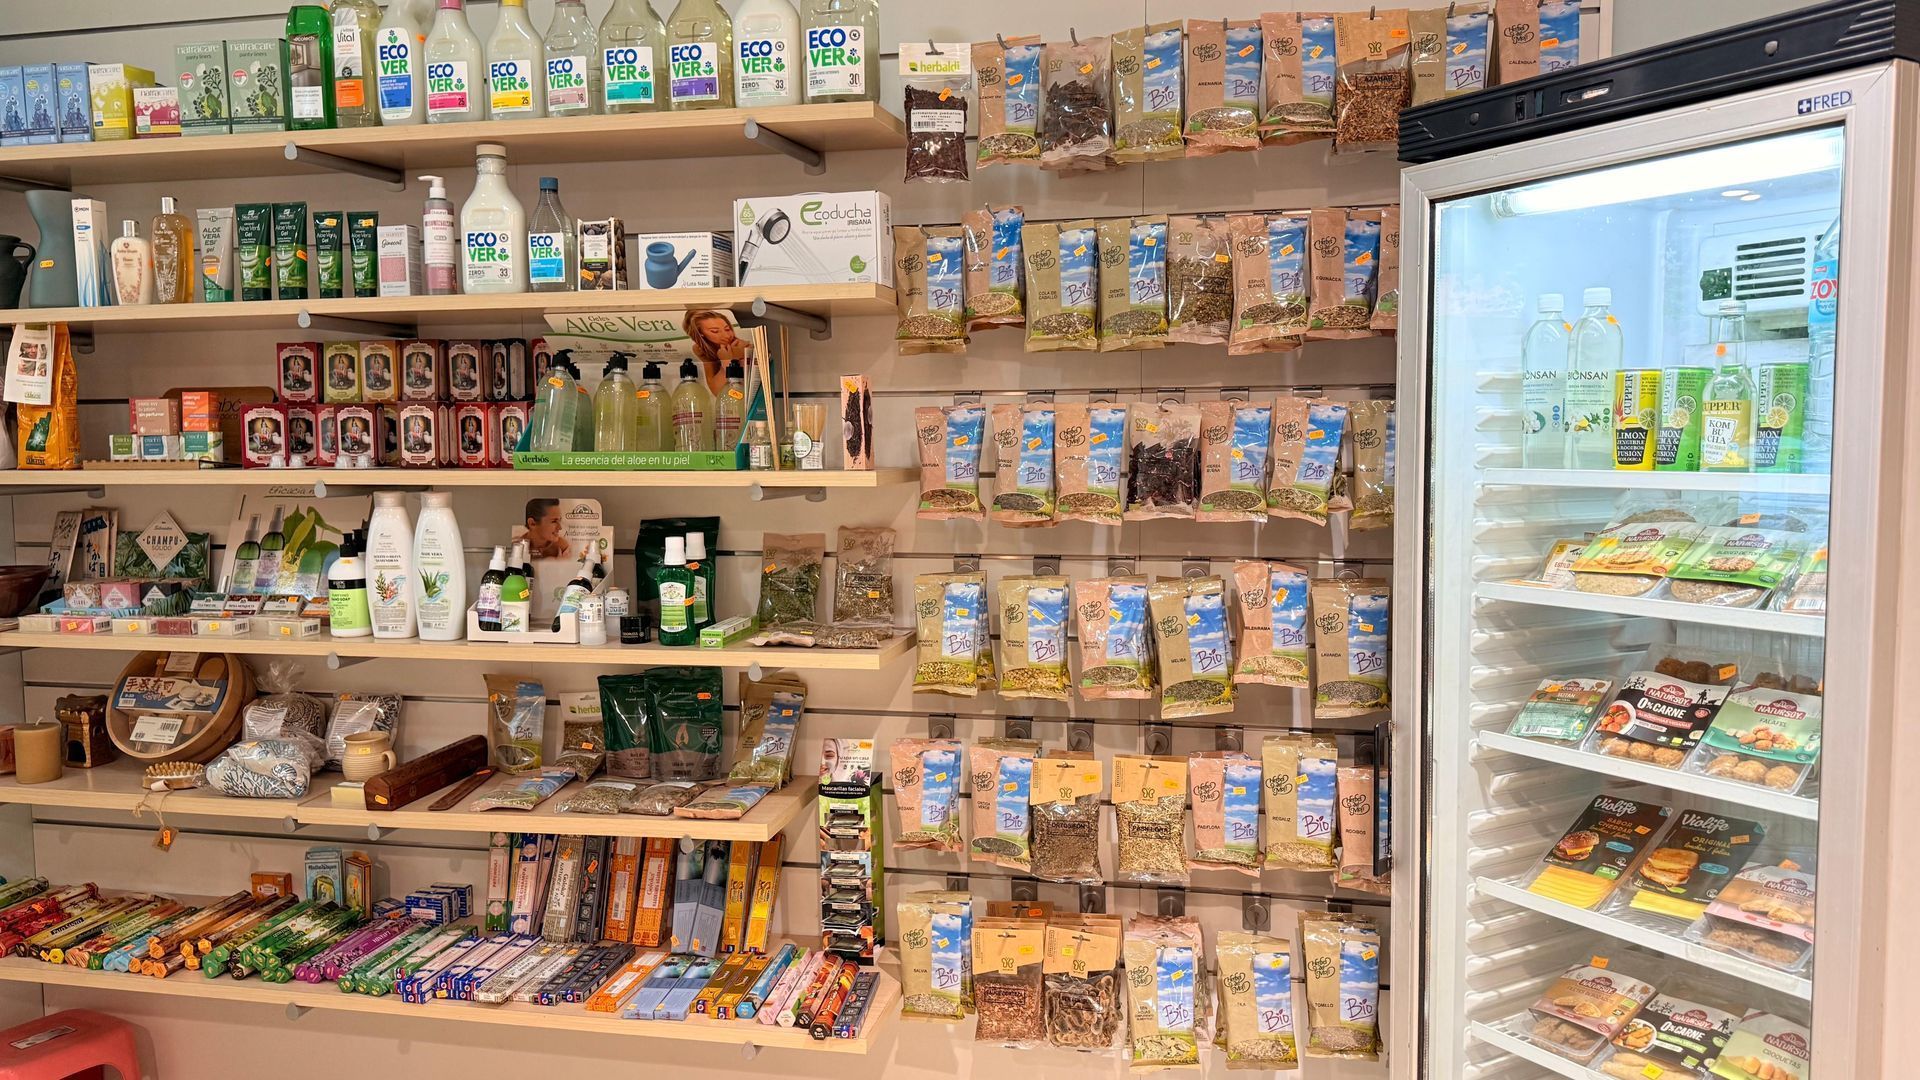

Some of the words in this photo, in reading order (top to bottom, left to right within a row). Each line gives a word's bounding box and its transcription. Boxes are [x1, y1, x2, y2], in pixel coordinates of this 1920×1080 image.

[809, 28, 846, 49] ECO
[229, 42, 276, 54] natracare
[379, 43, 408, 60] ECO
[671, 44, 702, 62] ECO
[741, 40, 772, 57] ECO
[606, 48, 637, 65] ECO
[809, 48, 846, 67] VER
[380, 59, 408, 75] VER
[428, 63, 454, 79] ECO
[491, 62, 517, 78] ECO
[548, 58, 573, 74] ECO
[607, 65, 637, 81] VER
[672, 62, 701, 78] VER
[741, 57, 773, 74] VER
[920, 61, 960, 73] herbaldi
[549, 74, 573, 89] VER
[775, 79, 784, 89] 33
[1451, 65, 1481, 87] Bio
[429, 78, 453, 92] VER
[492, 77, 517, 92] VER
[1232, 79, 1256, 95] Bio
[1147, 86, 1174, 109] Bio
[1813, 91, 1851, 111] FRED
[847, 218, 872, 227] IRISANA
[467, 232, 497, 248] ECO
[530, 235, 553, 248] ECO
[467, 247, 497, 262] VER
[530, 247, 552, 259] VER
[499, 268, 508, 278] 33
[1066, 282, 1092, 304] Bio
[1134, 279, 1161, 302] Bio
[565, 317, 619, 334] Aloe
[618, 315, 677, 333] Vera
[1624, 373, 1633, 416] CUPPER
[1709, 419, 1730, 429] KOM
[1712, 428, 1723, 436] BU
[1616, 431, 1646, 440] LIMÓN
[1707, 436, 1726, 445] CHA
[561, 454, 573, 465] La
[574, 454, 608, 465] esencia
[610, 453, 625, 465] del
[626, 454, 647, 465] aloe
[648, 456, 660, 465] en
[661, 455, 672, 465] tu
[673, 454, 690, 468] piel
[952, 462, 974, 479] Bio
[1025, 467, 1046, 483] Bio
[1239, 461, 1260, 478] Bio
[1301, 462, 1323, 479] Bio
[948, 634, 972, 653] Bio
[1279, 628, 1303, 644] Bio
[1033, 640, 1057, 659] Bio
[1195, 649, 1222, 670] Bio
[1353, 652, 1383, 672] Bio
[1648, 689, 1690, 706] NATURSOY
[1637, 697, 1653, 710] 0%
[1652, 702, 1687, 720] CARNE
[1757, 705, 1805, 720] NATURSOY
[1594, 797, 1637, 817] Violife
[1003, 812, 1023, 829] Bio
[1302, 814, 1330, 837] Bio
[1598, 821, 1633, 835] CHEDDAR
[1607, 817, 1633, 828] SABOR
[1681, 813, 1729, 834] Violife
[1232, 822, 1255, 839] Bio
[1692, 835, 1732, 849] ORIGINAL
[1767, 882, 1814, 898] NATURSOY
[935, 968, 959, 989] Bio
[1581, 979, 1613, 993] NATURSOY
[1161, 1004, 1188, 1024] Bio
[1345, 998, 1372, 1019] Bio
[1261, 1009, 1289, 1029] Bio
[1673, 1013, 1711, 1029] NATURSOY
[1673, 1025, 1706, 1042] CARNE
